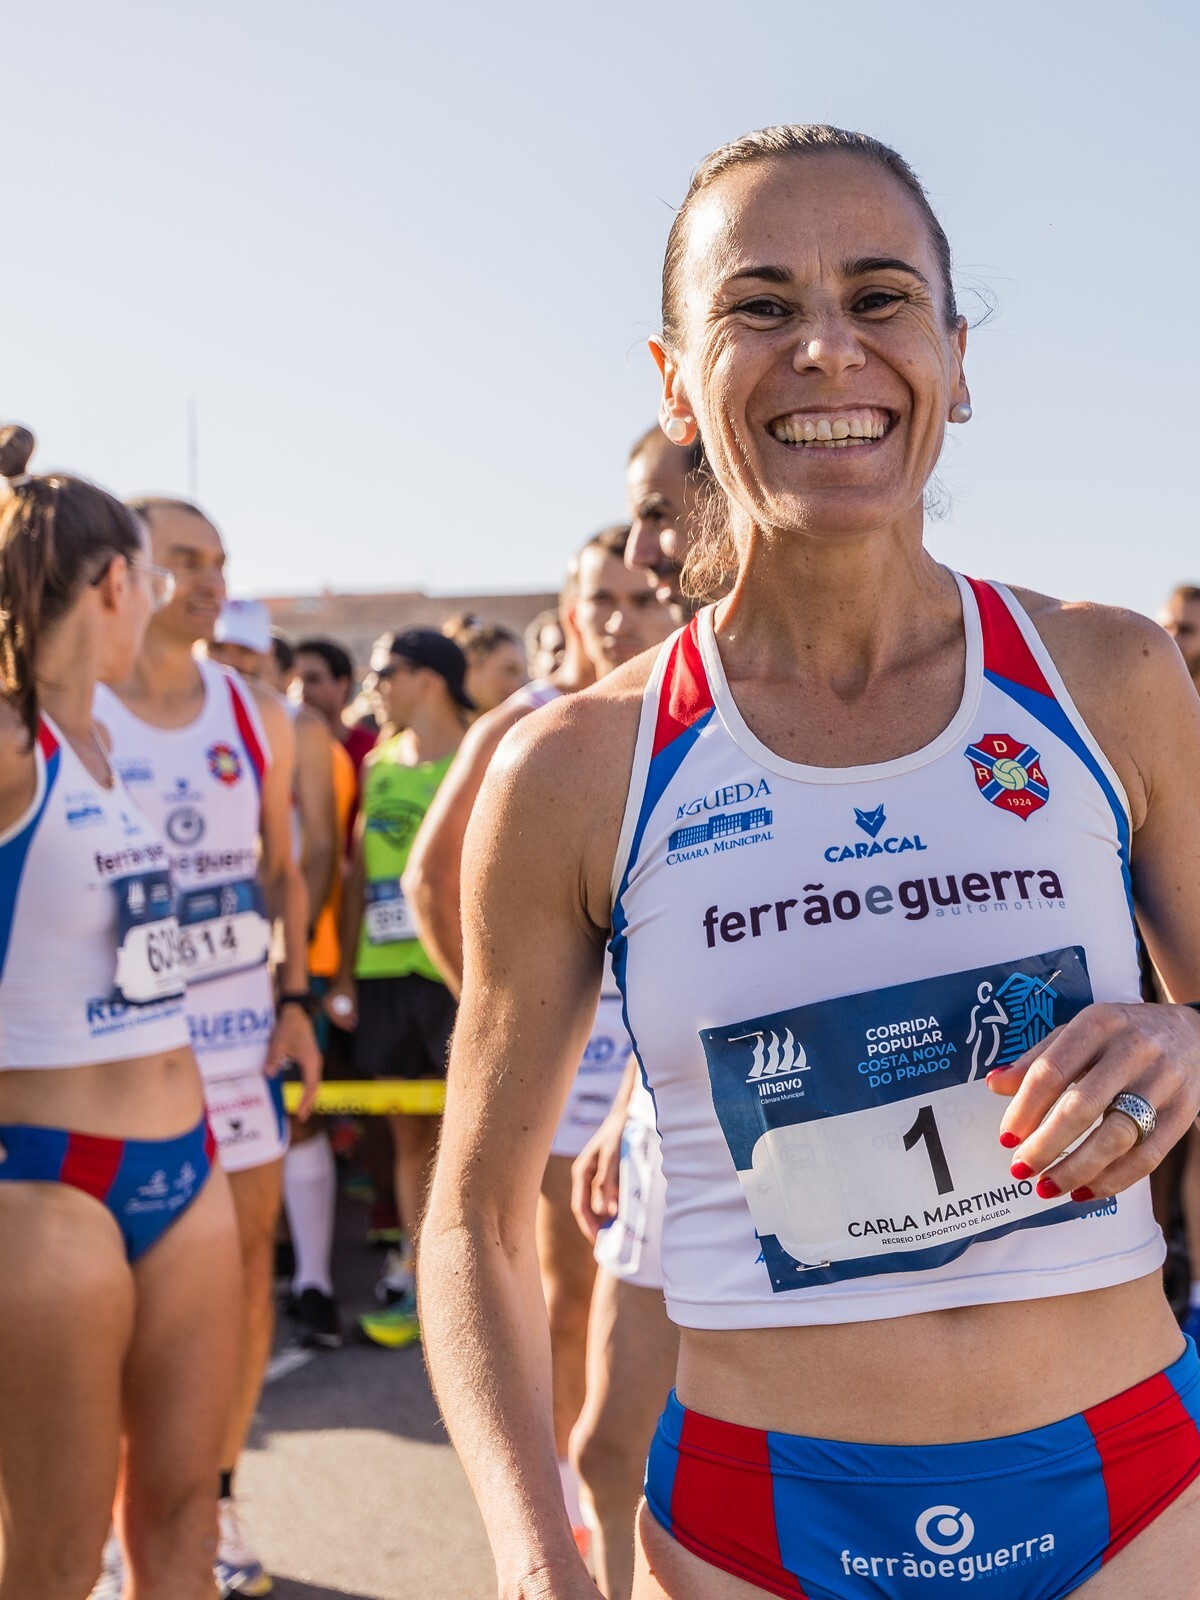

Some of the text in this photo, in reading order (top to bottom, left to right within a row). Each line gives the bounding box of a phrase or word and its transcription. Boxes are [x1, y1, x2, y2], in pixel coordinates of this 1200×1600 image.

[993, 740, 1008, 753] D
[975, 767, 1044, 780] R A
[1007, 797, 1032, 807] 1924
[713, 831, 774, 854] MUNICIPAL
[824, 835, 927, 863] CARACAL
[935, 898, 1067, 918] automotive
[866, 1015, 939, 1041] CORRIDA
[867, 1030, 943, 1057] POPULAR
[858, 1042, 957, 1075] COSTA NOVA
[868, 1058, 951, 1089] DO PRADO
[780, 1090, 805, 1101] Municipal
[902, 1105, 954, 1196] 1
[848, 1180, 1033, 1238] CARLA MARTINHO
[881, 1208, 1011, 1246] RECREIO DESPORTIVO DE ÁGUEDA
[977, 1550, 1055, 1580] automotive
